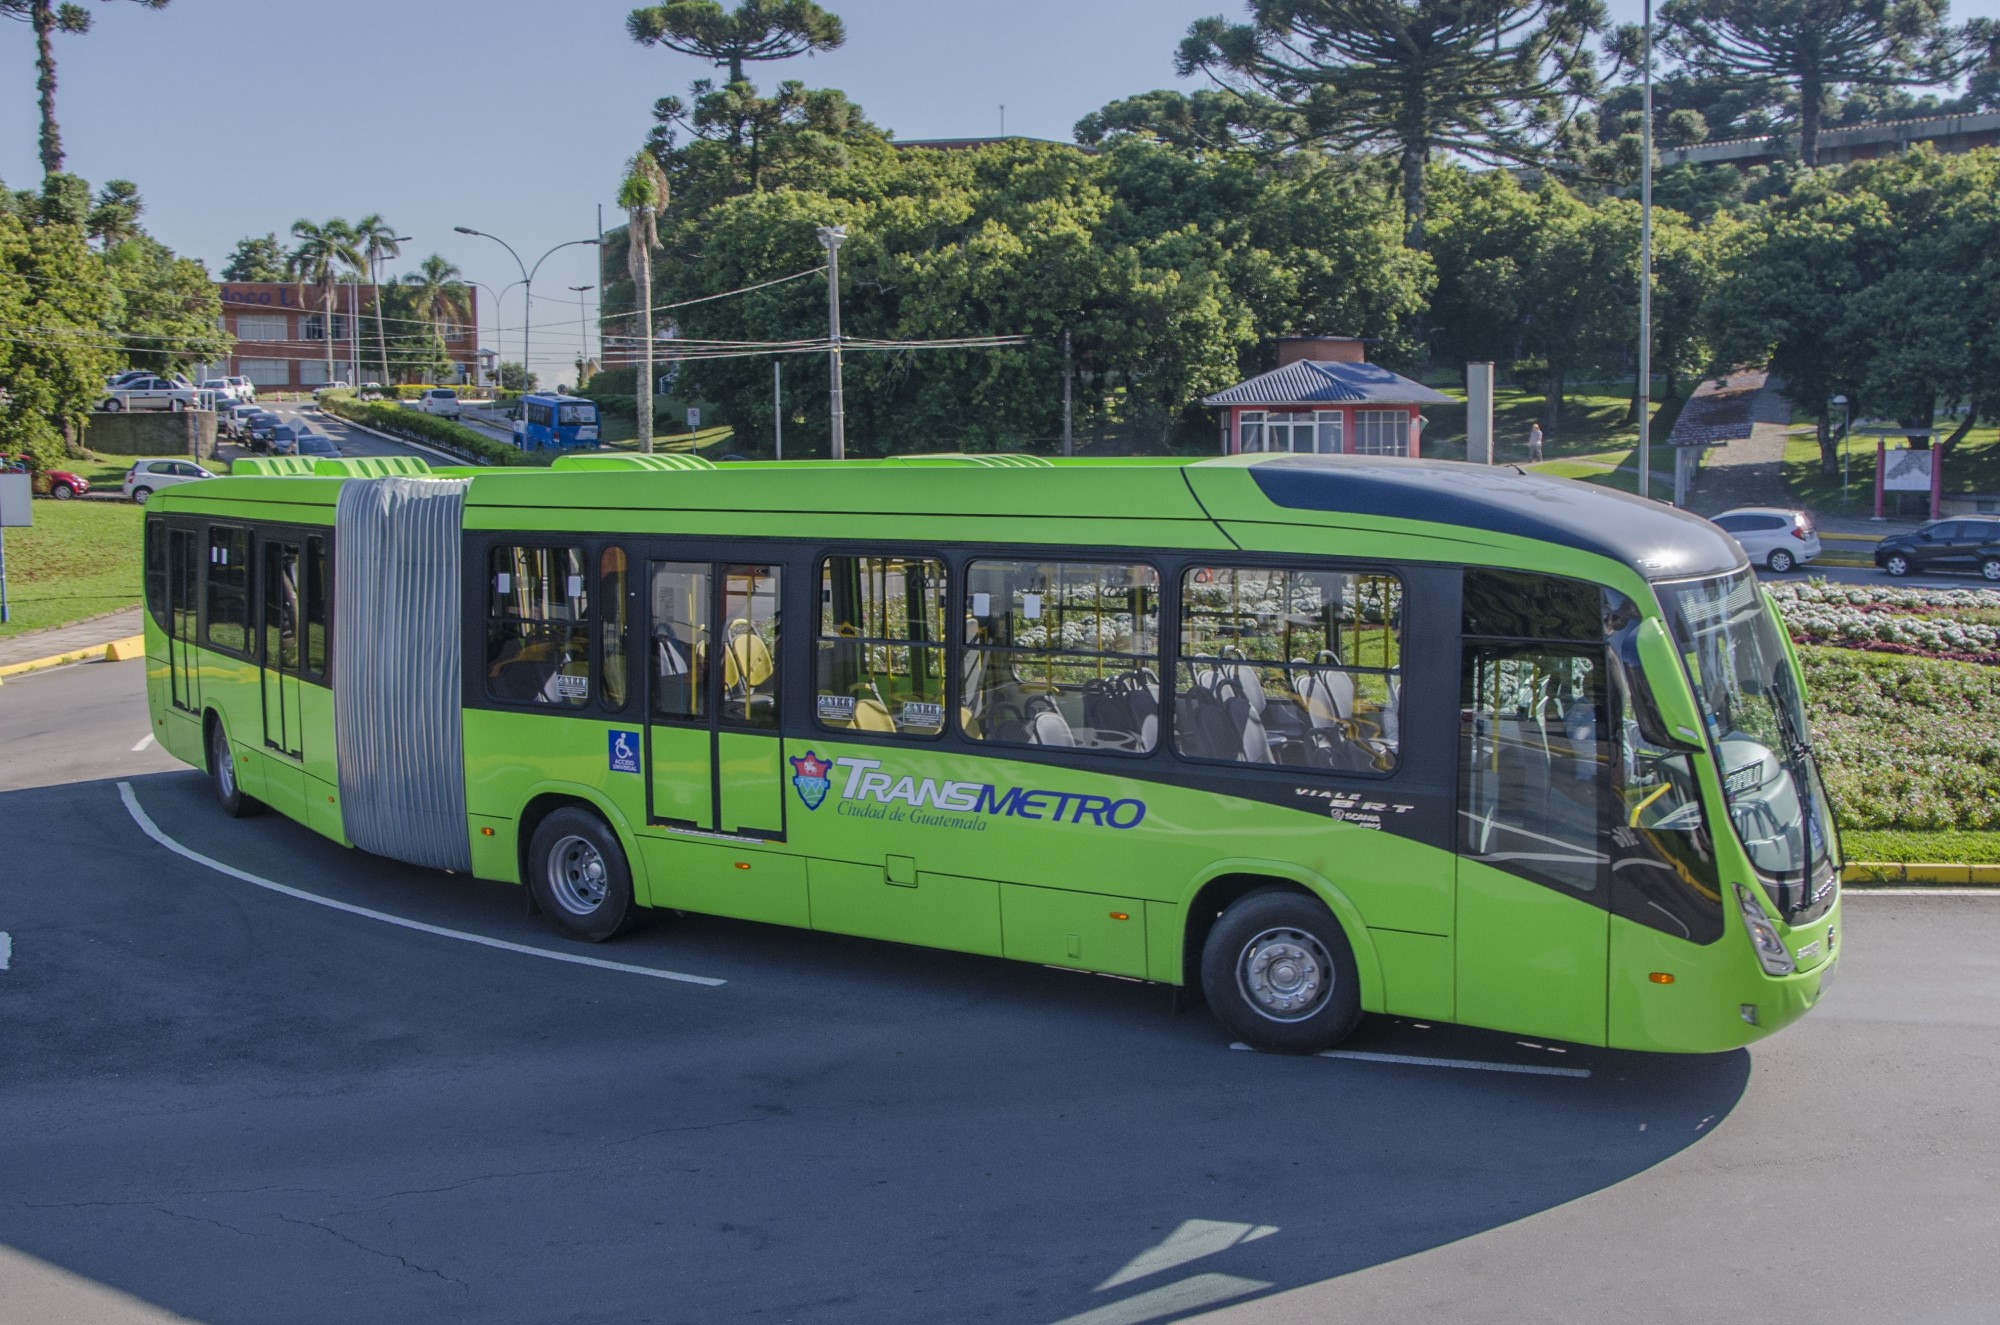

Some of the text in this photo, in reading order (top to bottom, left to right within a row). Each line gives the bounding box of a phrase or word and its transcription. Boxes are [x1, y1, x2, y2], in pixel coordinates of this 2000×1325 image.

[1295, 788, 1361, 800] VIALE
[1329, 799, 1414, 813] BRT
[837, 800, 987, 832] Ciudad de Guatemala
[1344, 812, 1381, 822] SCANIA
